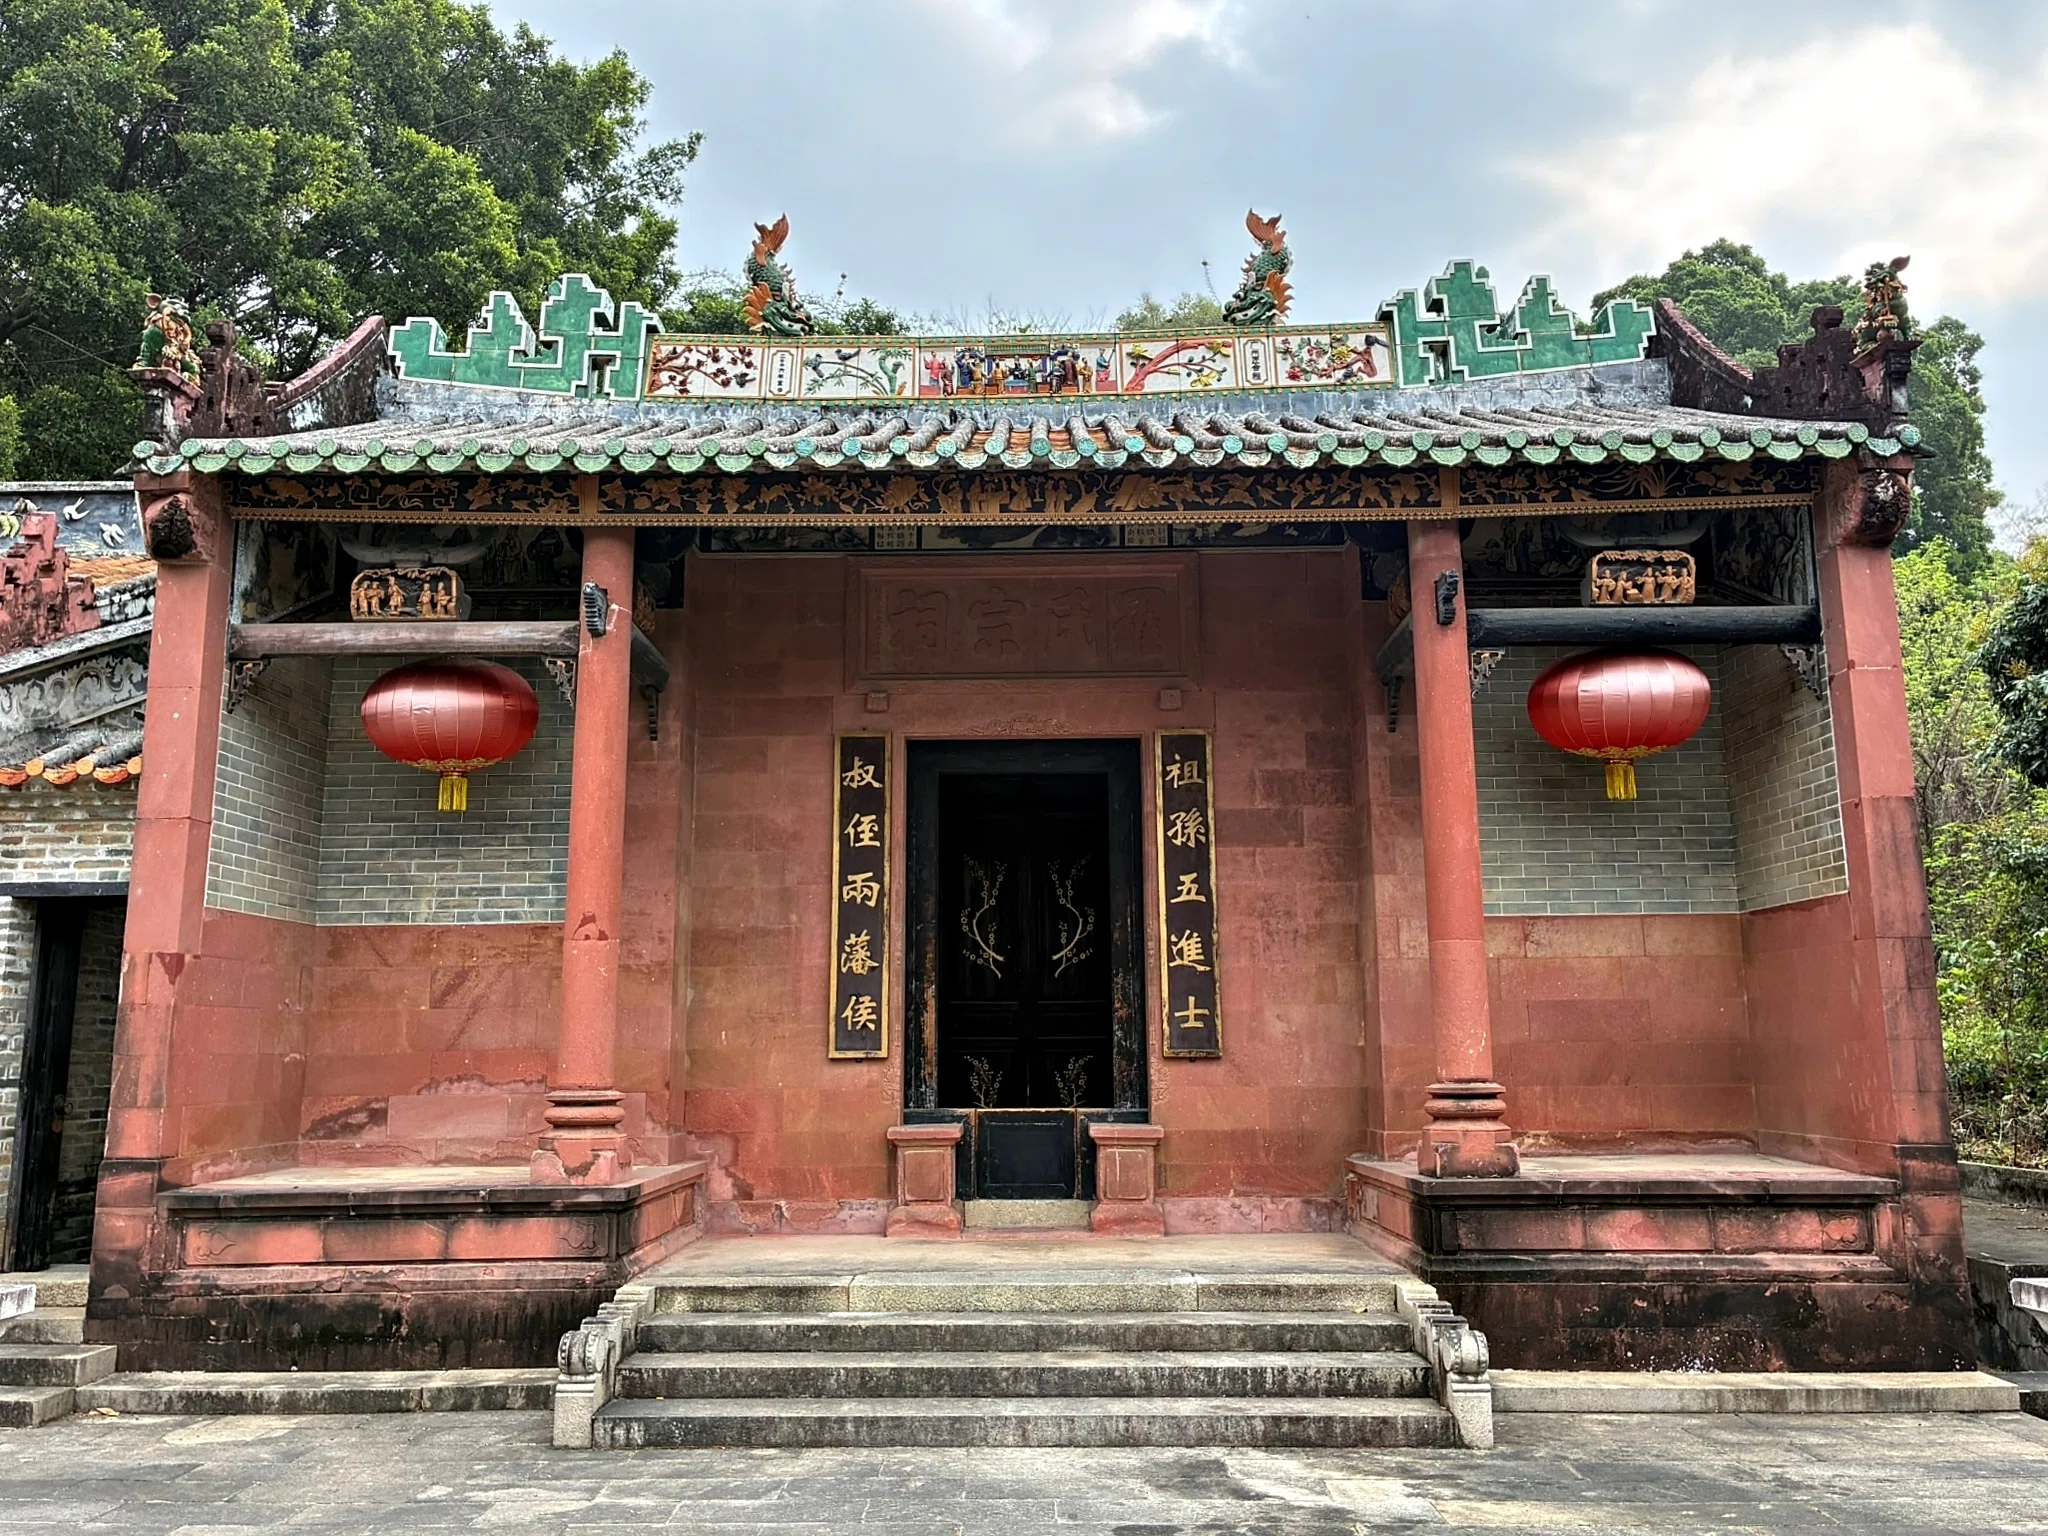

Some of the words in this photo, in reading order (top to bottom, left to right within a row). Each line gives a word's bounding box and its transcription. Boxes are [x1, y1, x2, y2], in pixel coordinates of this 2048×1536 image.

[840, 755, 884, 1032] 叔侄兩藩侯
[1164, 753, 1212, 1029] 祖孫五進士
